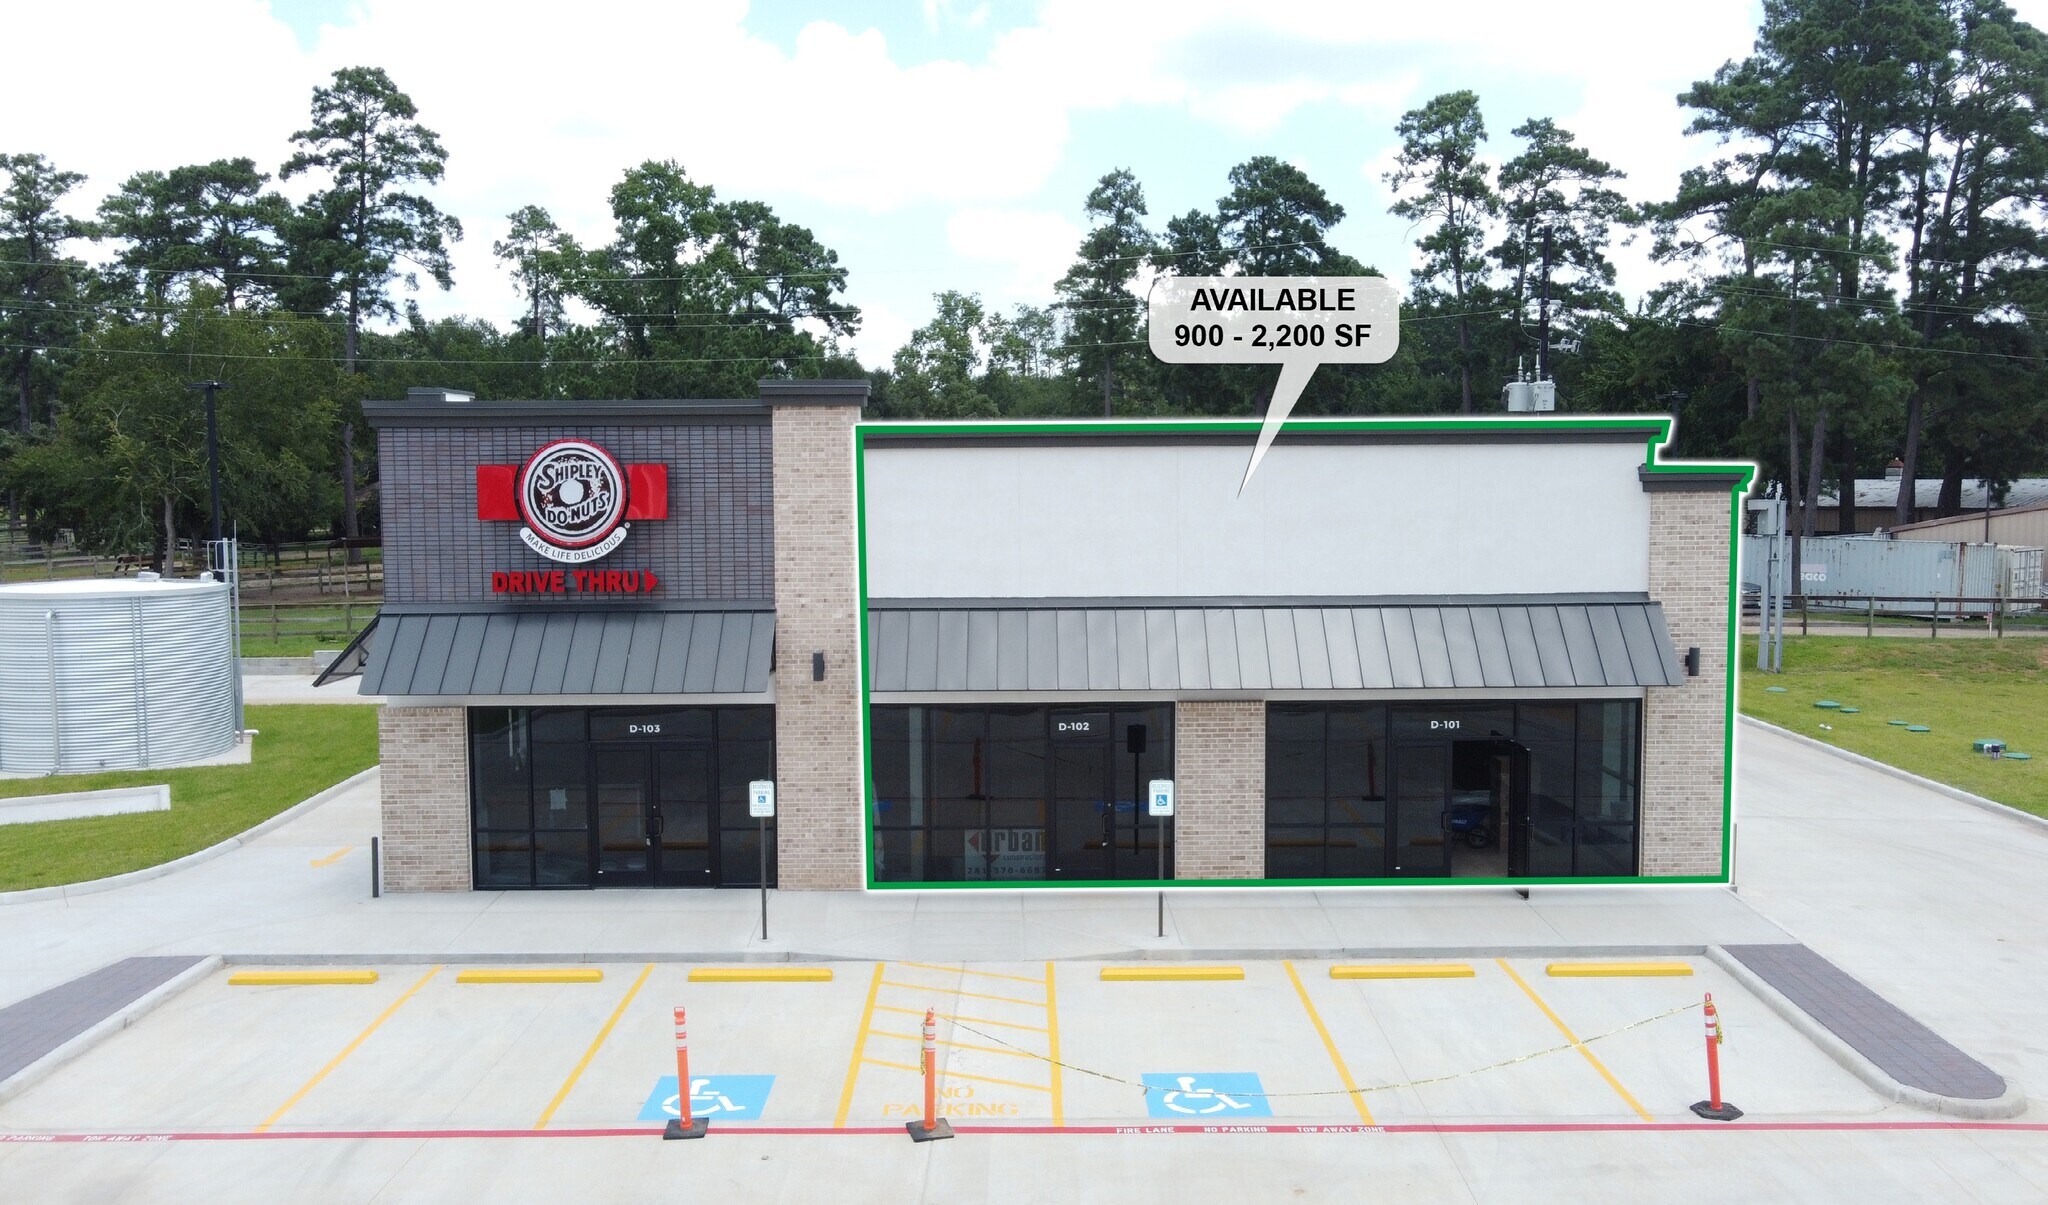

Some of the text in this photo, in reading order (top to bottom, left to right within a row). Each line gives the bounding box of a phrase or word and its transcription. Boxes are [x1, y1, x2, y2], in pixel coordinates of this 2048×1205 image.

[539, 463, 602, 490] SHIPLEY
[525, 533, 621, 560] MAKE LIFE DELICIOUS
[492, 570, 640, 593] DRIVE THRU
[629, 724, 661, 733] D-103
[1058, 722, 1090, 731] D-102
[1430, 720, 1460, 729] D-101
[933, 1086, 975, 1099] NO
[1116, 1126, 1176, 1135] FIRE LANE
